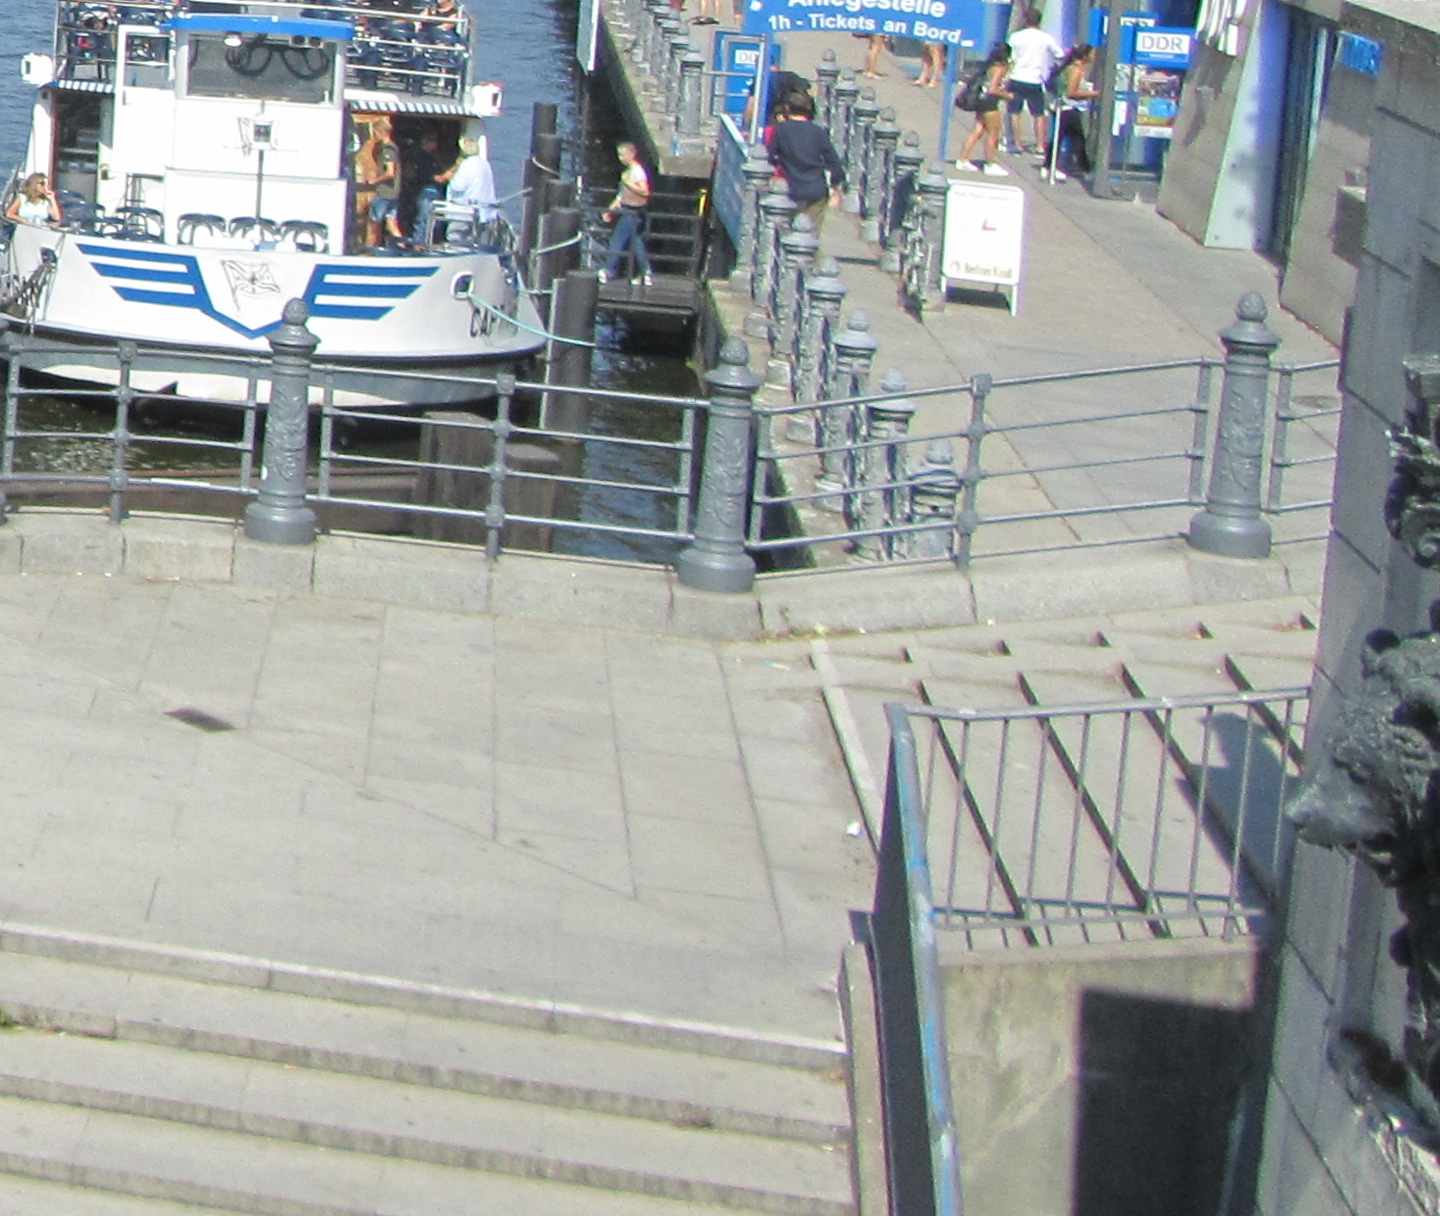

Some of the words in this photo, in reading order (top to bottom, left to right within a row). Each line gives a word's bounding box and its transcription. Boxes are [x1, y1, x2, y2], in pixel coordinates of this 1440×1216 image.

[768, 14, 791, 30] 1h
[808, 13, 875, 31] Tickets
[883, 21, 906, 35] an
[914, 21, 962, 44] Bord
[1140, 34, 1184, 53] DDR
